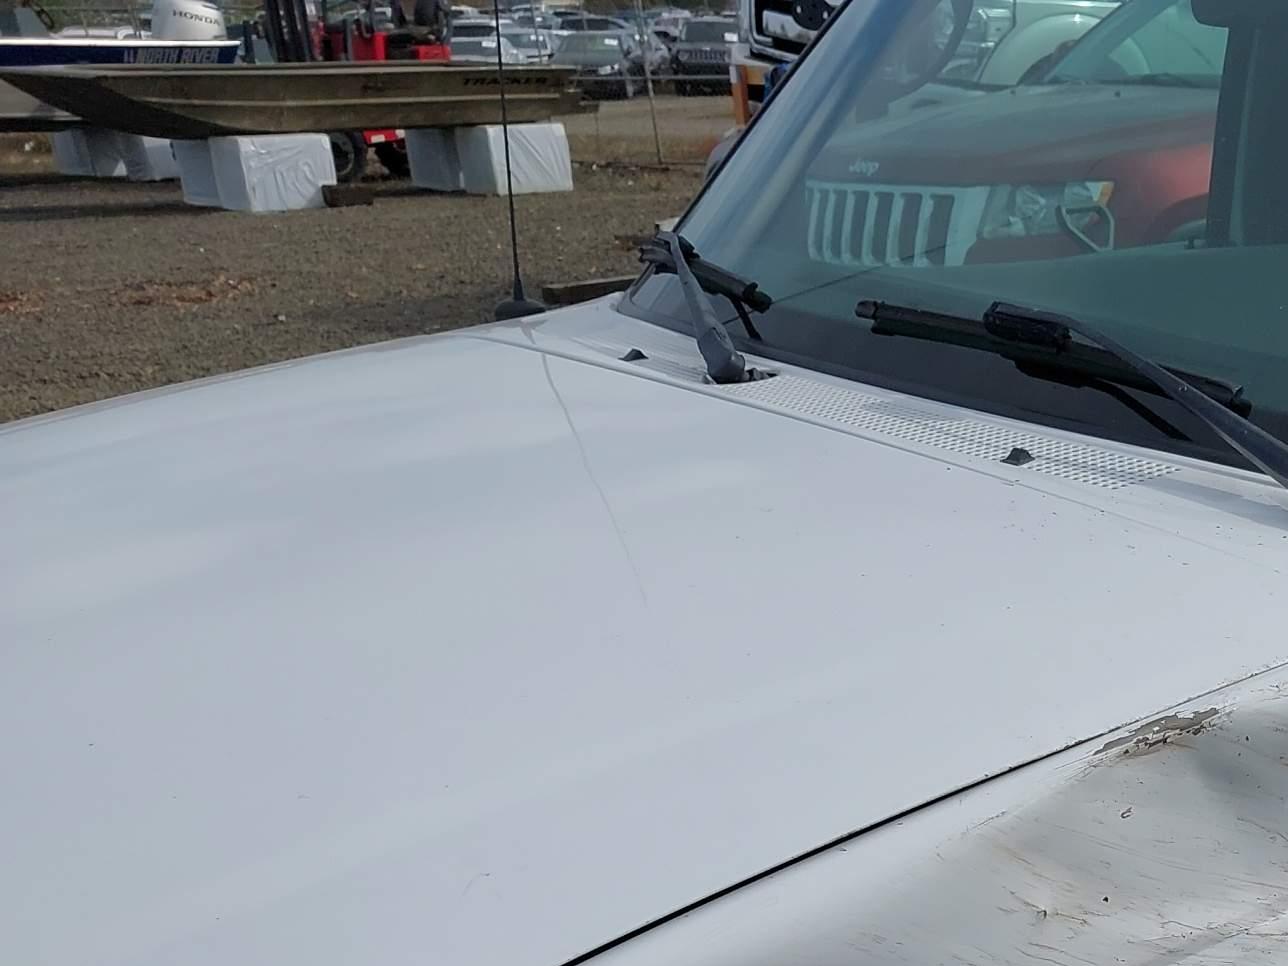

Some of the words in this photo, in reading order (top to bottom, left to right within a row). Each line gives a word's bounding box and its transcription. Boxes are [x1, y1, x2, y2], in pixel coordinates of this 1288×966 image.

[172, 8, 221, 26] HONDA
[136, 48, 179, 64] NORTH
[181, 48, 220, 64] RIVER
[463, 77, 549, 86] TRACKER
[848, 158, 880, 177] Jeep
